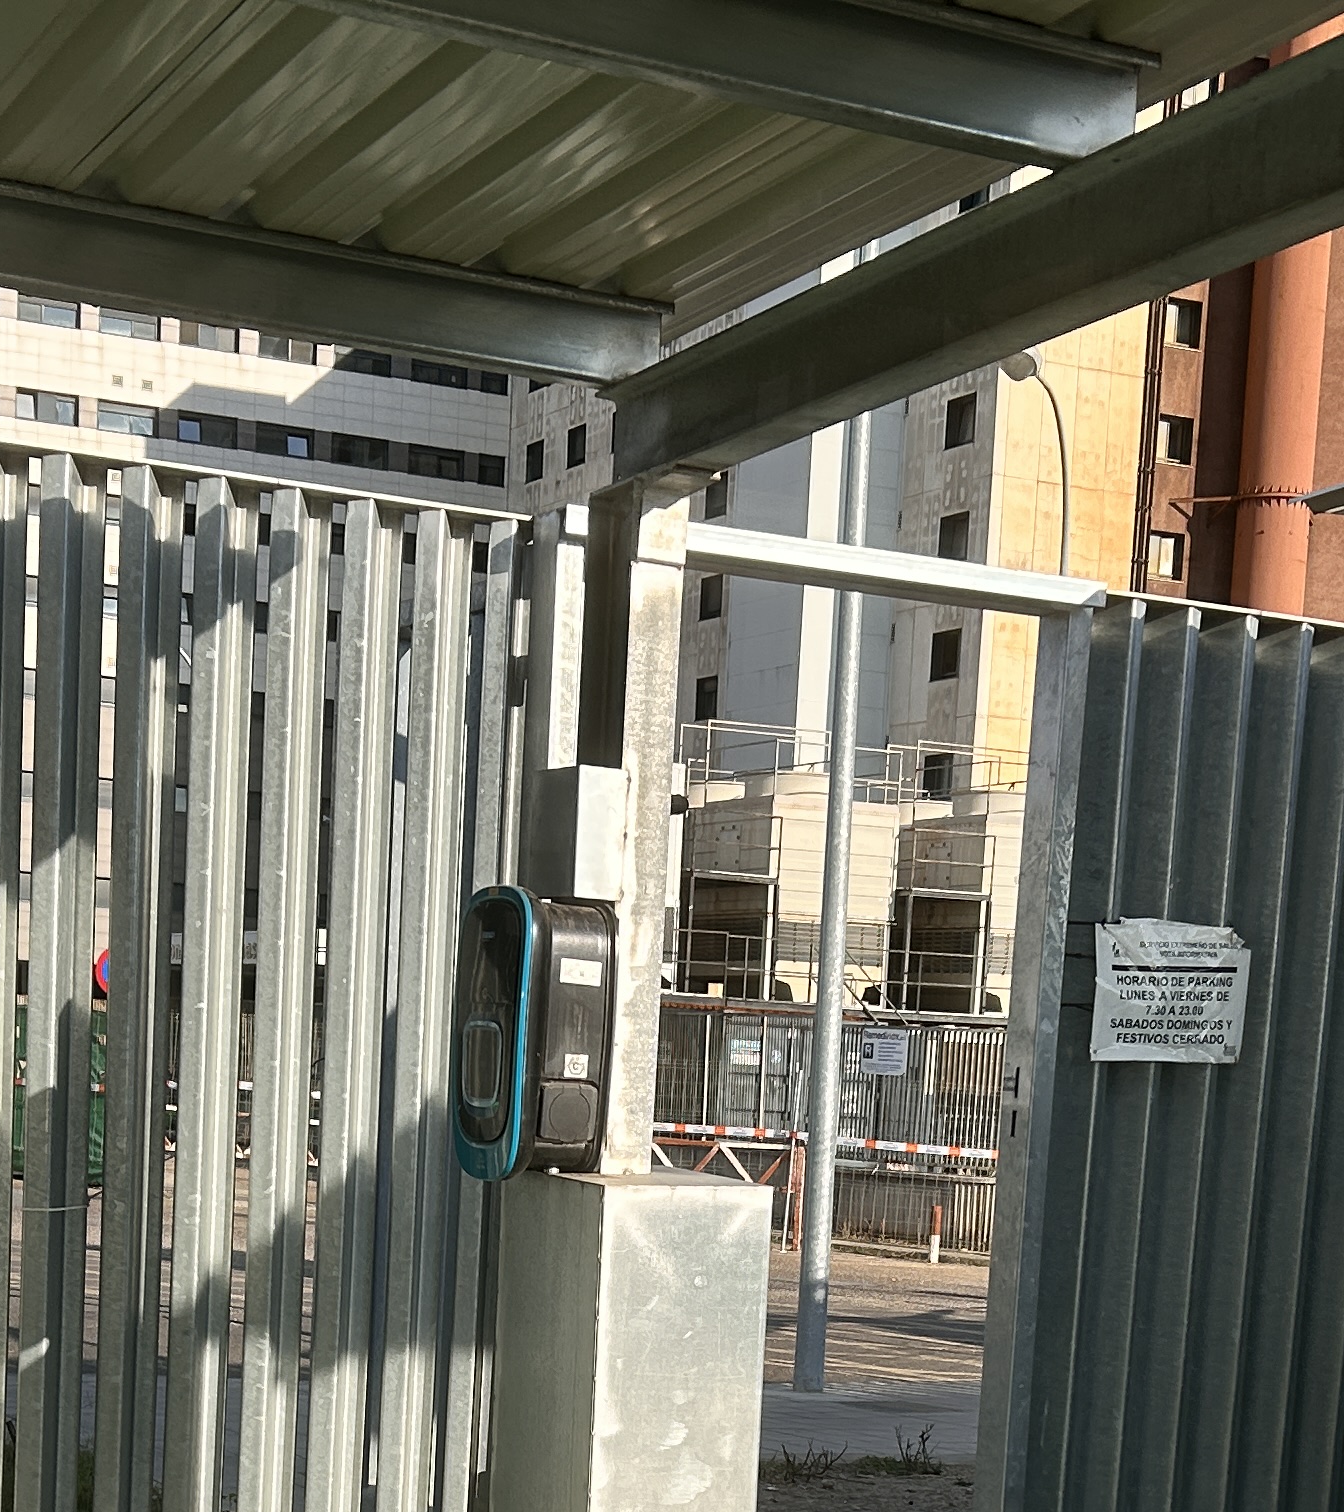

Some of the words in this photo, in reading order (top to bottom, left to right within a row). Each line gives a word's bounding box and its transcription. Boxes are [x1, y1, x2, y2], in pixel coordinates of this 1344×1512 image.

[1116, 975, 1169, 987] HORARIO
[1170, 976, 1185, 987] DE
[1188, 976, 1233, 987] PARKING
[1119, 989, 1155, 1001] LUNES
[1158, 991, 1167, 1001] A
[1170, 990, 1213, 1001] VIERNES
[1216, 991, 1230, 1001] DE
[1145, 1005, 1167, 1016] 7.30
[1168, 1006, 1176, 1016] A
[1178, 1006, 1204, 1016] 23.00
[1110, 1018, 1164, 1030] SABADOS
[1167, 1020, 1224, 1030] DOMINGOS
[1226, 1020, 1233, 1030] Y
[1116, 1033, 1169, 1045] FESTIVOS
[1172, 1034, 1225, 1045] CERRADO
